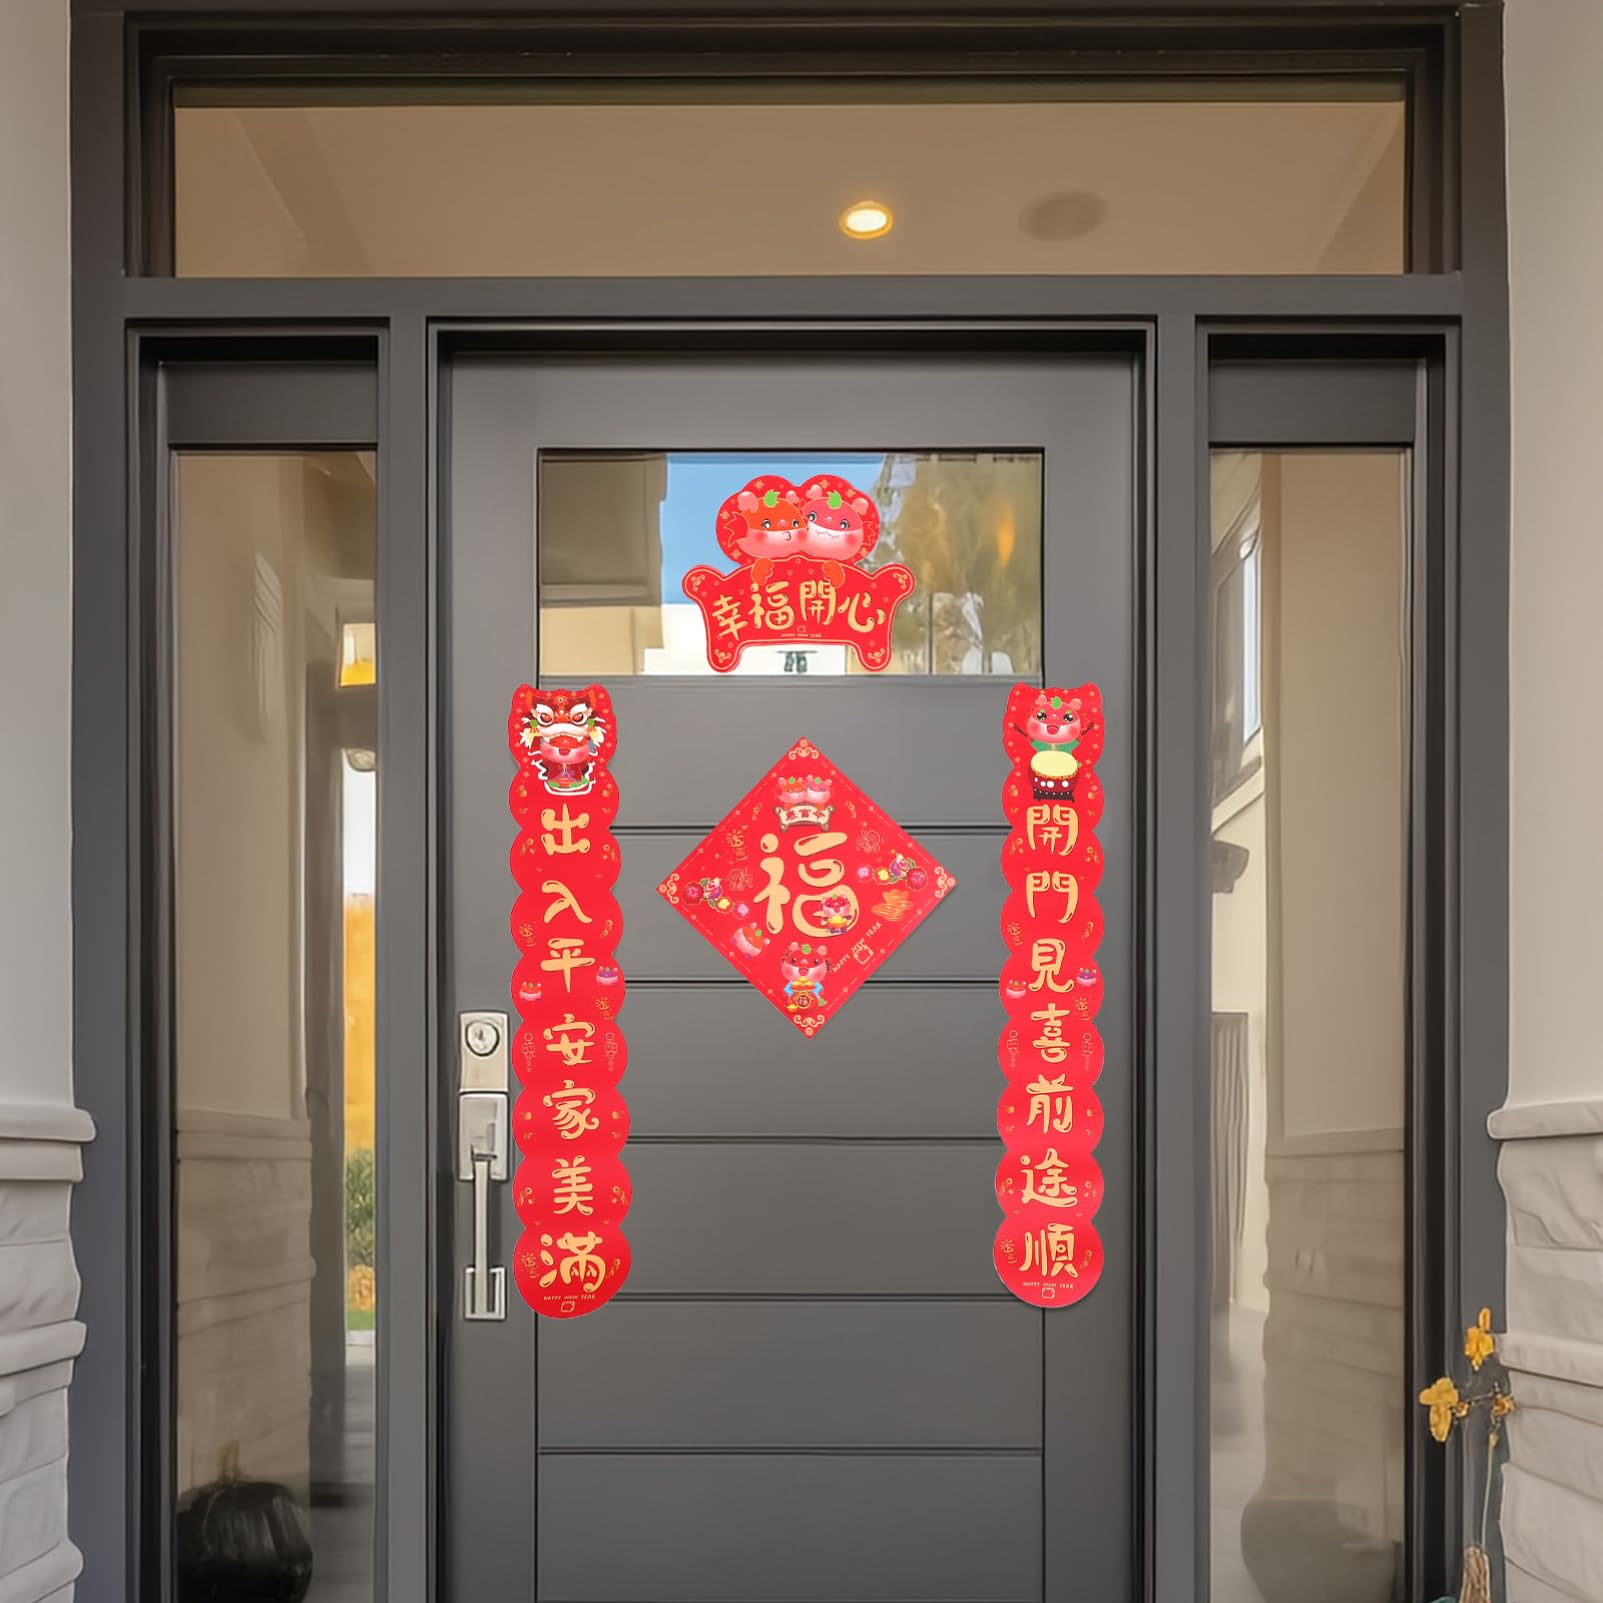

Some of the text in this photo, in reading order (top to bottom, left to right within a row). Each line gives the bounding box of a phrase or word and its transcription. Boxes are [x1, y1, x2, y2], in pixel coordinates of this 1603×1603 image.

[712, 579, 886, 640] 幸福開心
[753, 832, 860, 938] 福
[539, 803, 606, 1292] 出入平安家美滿
[1019, 803, 1079, 1278] 開門見喜前途順
